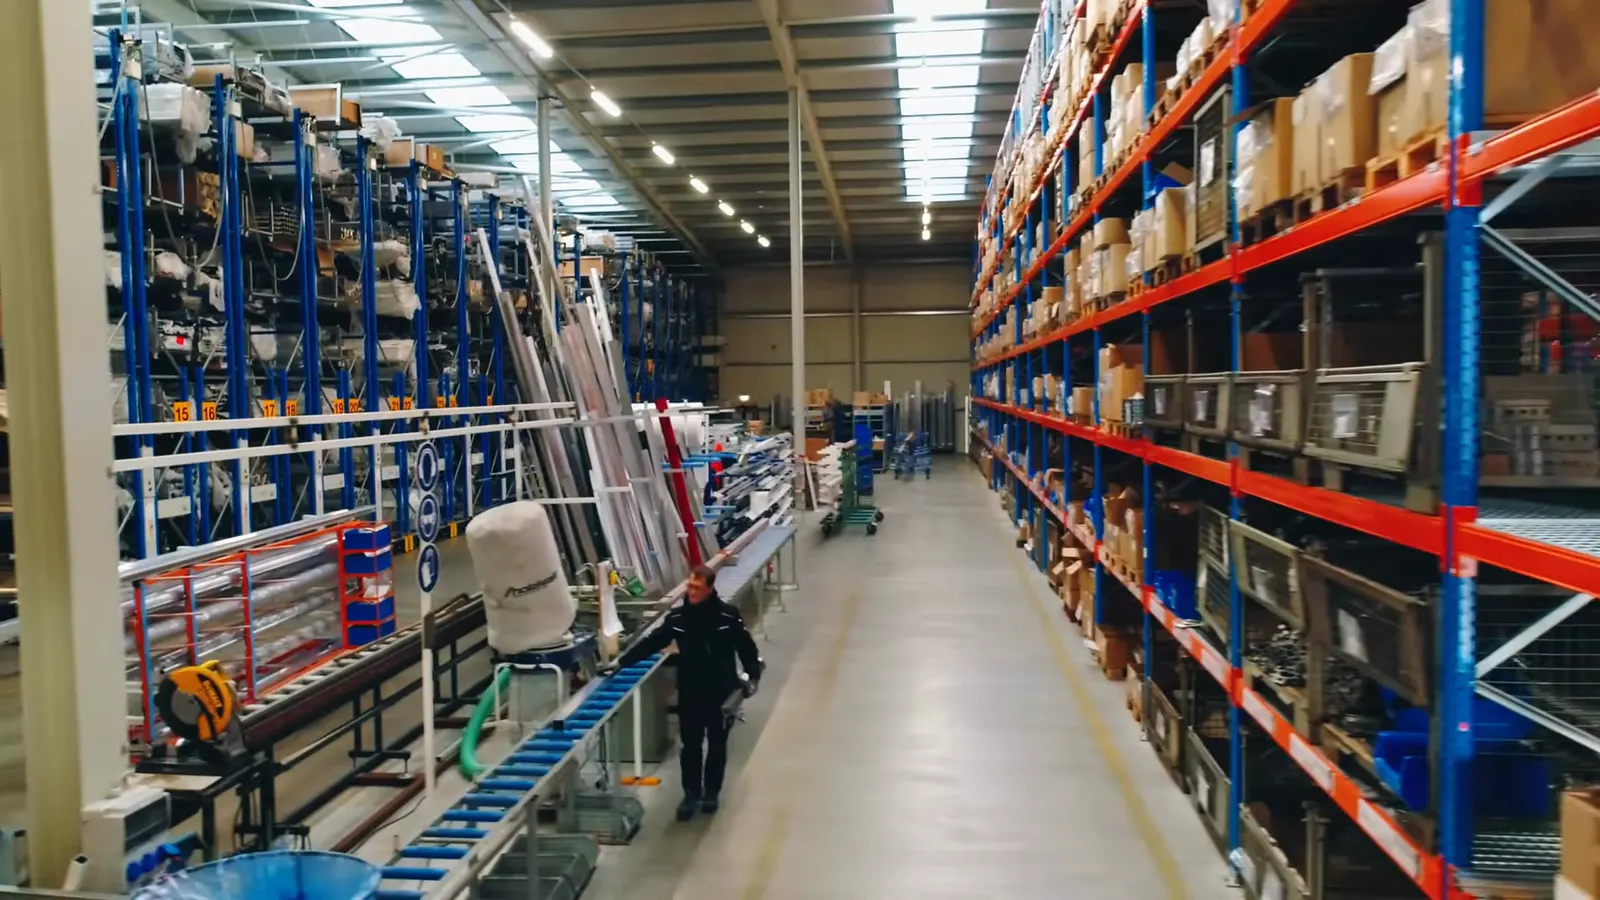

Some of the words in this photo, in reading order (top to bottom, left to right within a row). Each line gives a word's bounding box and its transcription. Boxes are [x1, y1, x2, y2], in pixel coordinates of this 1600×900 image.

[175, 407, 189, 421] 15
[203, 406, 215, 421] 16
[264, 404, 275, 417] 17
[286, 403, 296, 417] 18
[334, 402, 344, 415] 19
